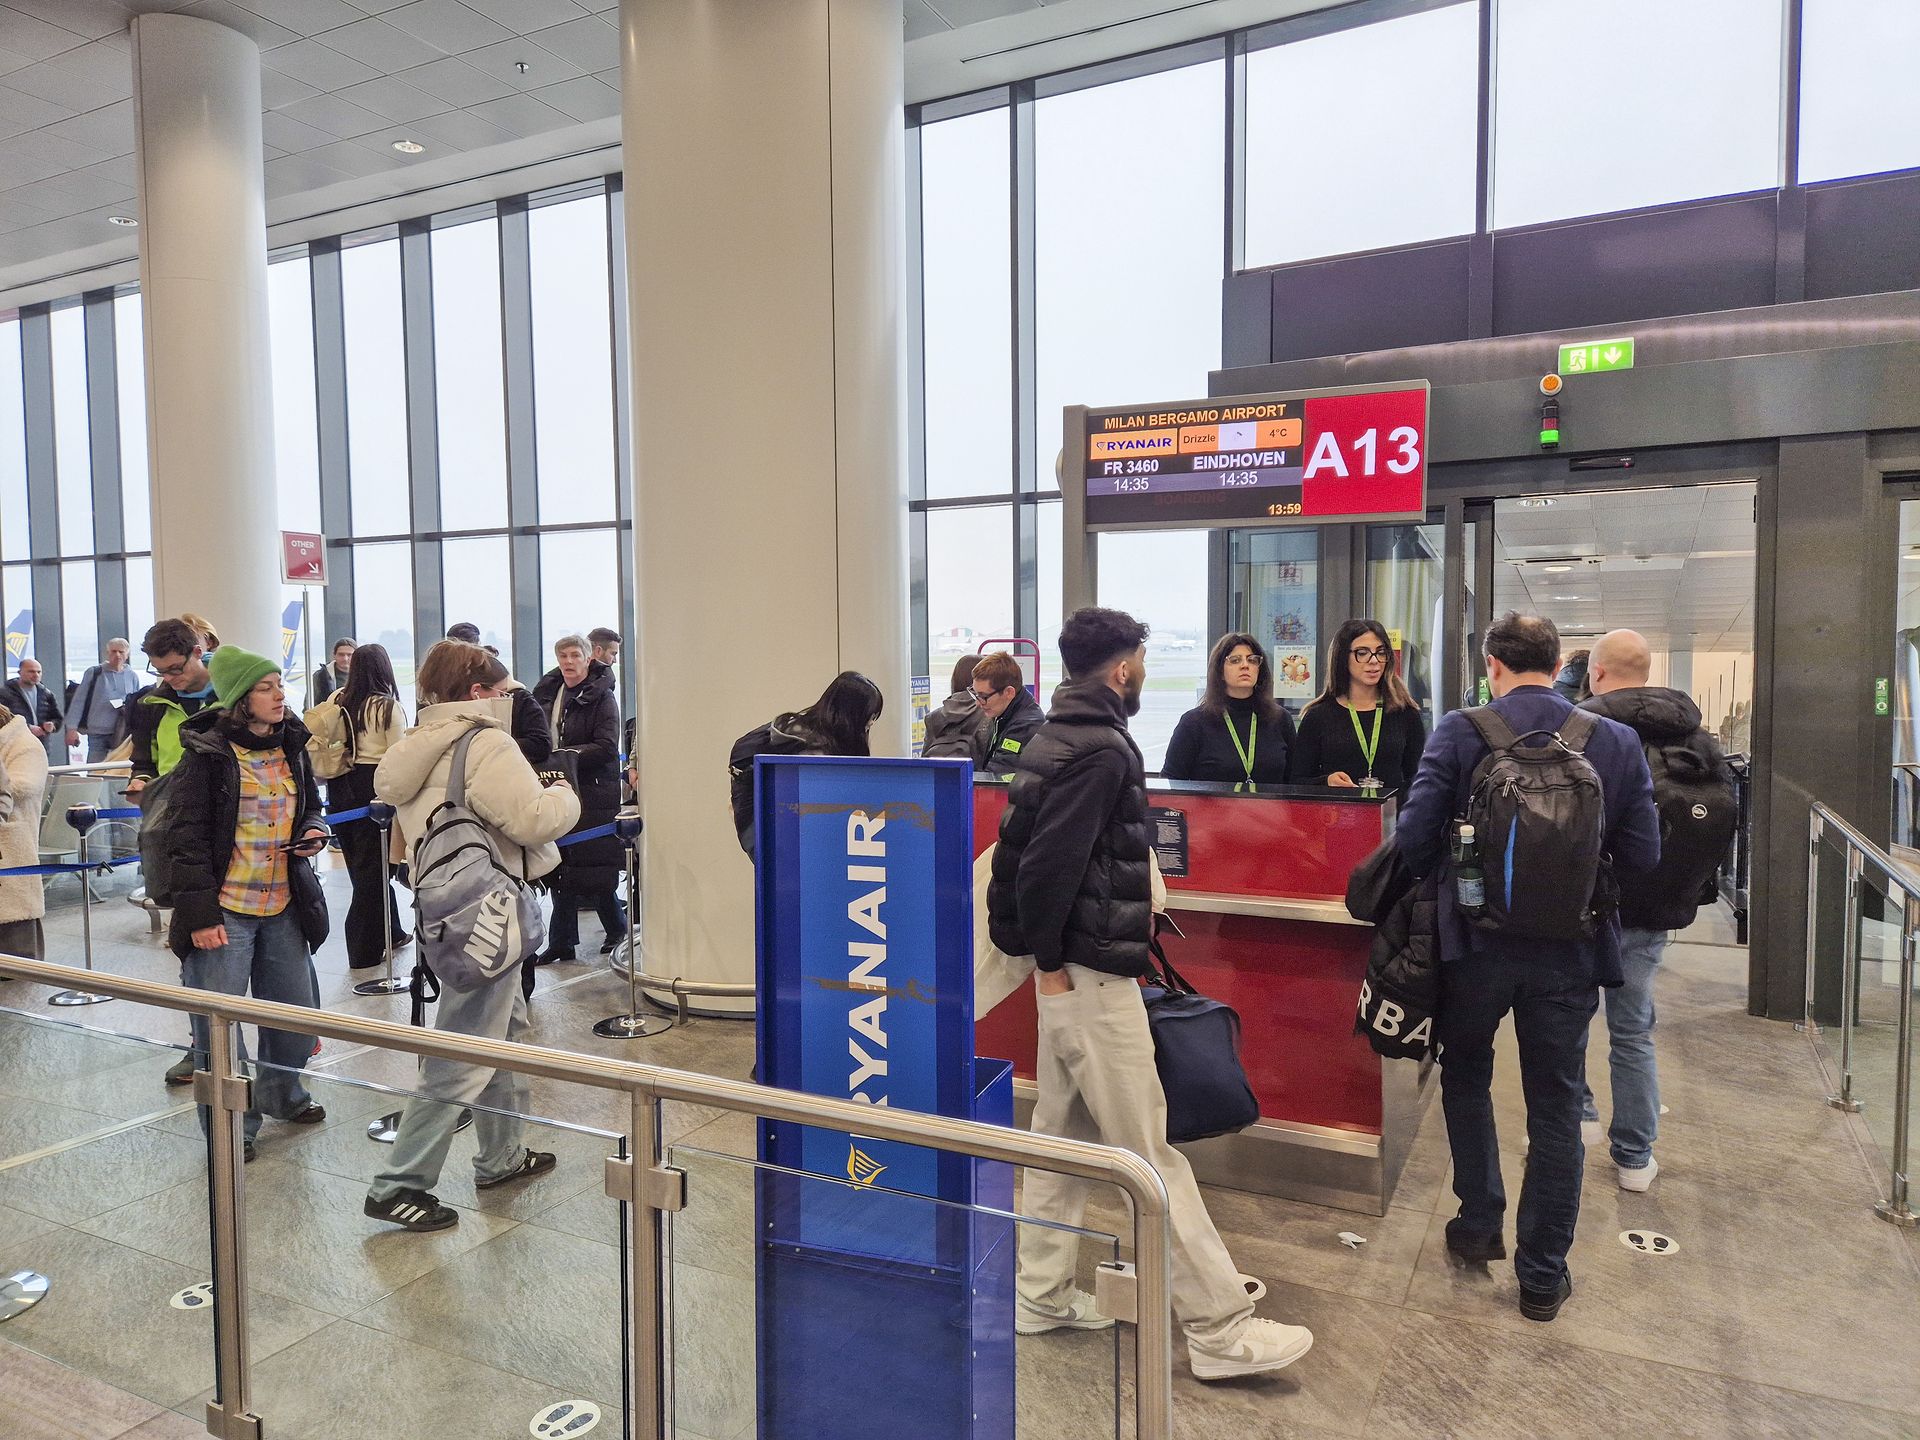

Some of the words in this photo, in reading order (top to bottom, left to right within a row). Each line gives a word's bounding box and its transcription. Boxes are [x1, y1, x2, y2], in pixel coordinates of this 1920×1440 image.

[1104, 415, 1145, 430] MILAN
[1149, 409, 1219, 427] BERGAMO
[1222, 403, 1287, 421] AIRPORT
[1107, 437, 1172, 451] RYANAIR
[1183, 433, 1216, 444] Drizzle
[1269, 428, 1288, 438] 4°C
[1193, 450, 1286, 470] EINDHOVEN
[1303, 426, 1421, 479] A13
[1104, 461, 1124, 475] FR
[1126, 459, 1159, 474] 3460
[1113, 477, 1149, 492] 14:35
[1219, 470, 1259, 487] 14:35
[1267, 502, 1302, 516] 13:59
[291, 540, 315, 549] OTHER
[300, 548, 307, 556] Q
[540, 770, 565, 779] INTS
[463, 888, 509, 969] NIKE
[1357, 978, 1444, 1064] RBA
